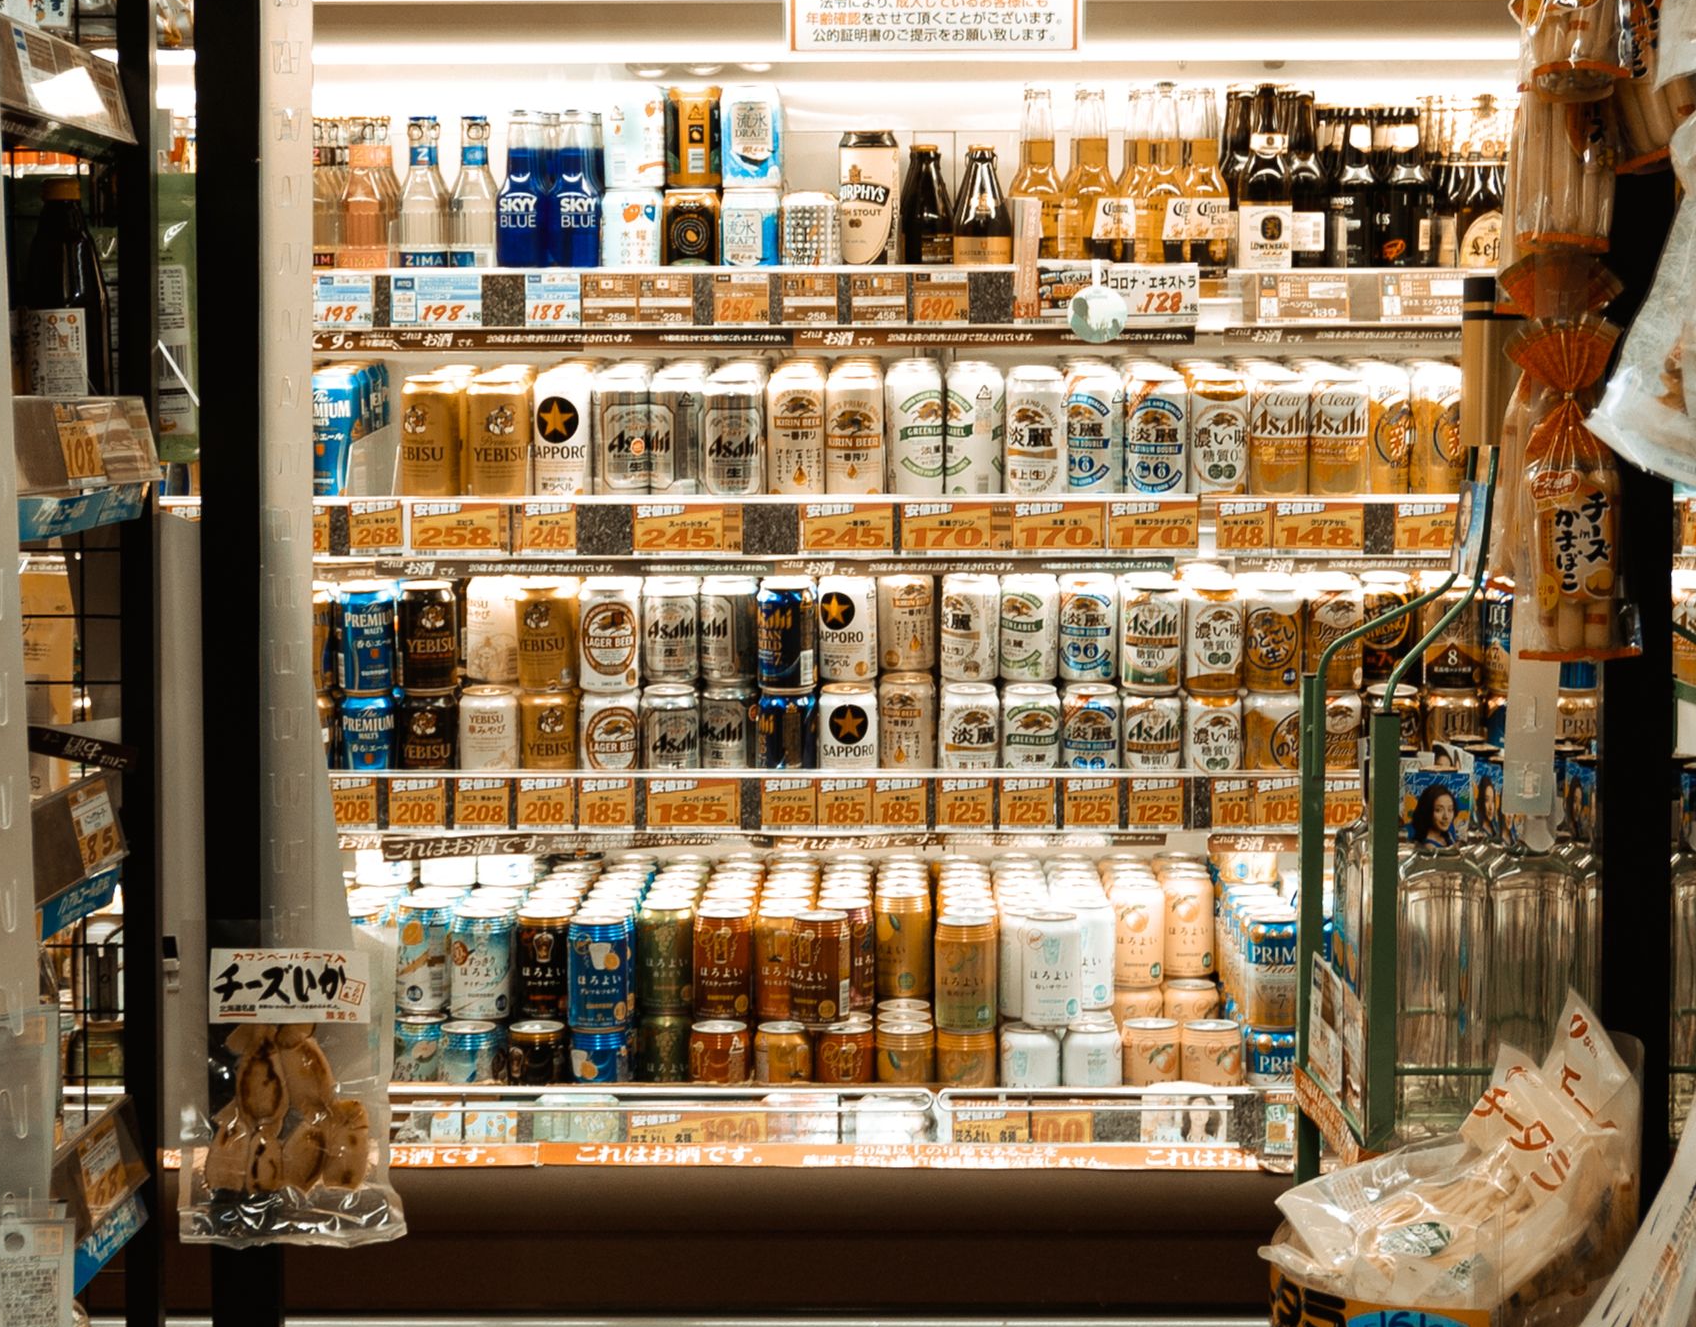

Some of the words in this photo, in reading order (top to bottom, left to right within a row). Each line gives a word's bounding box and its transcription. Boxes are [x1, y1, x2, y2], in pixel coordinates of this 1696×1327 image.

[806, 12, 1062, 26] 年齢確認をさせて頂くことがございます。
[813, 28, 1056, 43] 公的証明書のご提示をお願い致します。
[735, 125, 770, 139] DRAFT
[499, 198, 537, 212] SKYY
[559, 198, 597, 212] SKYY
[499, 215, 537, 229] BLUE
[559, 215, 597, 229] BLUE
[405, 254, 444, 267] ZIMA
[1109, 275, 1197, 289] コロナ・エキストラ
[1264, 393, 1304, 408] Clear
[1318, 393, 1358, 408] Clear
[706, 432, 760, 457] Asahi
[1008, 427, 1054, 450] 淡麗
[1130, 424, 1180, 444] 淡麗
[473, 447, 526, 462] YEBISU
[357, 527, 398, 547] 268
[415, 526, 492, 548] 258
[530, 526, 569, 549] 245
[640, 528, 715, 549] 245
[813, 526, 889, 548] 245
[909, 526, 982, 548] 170
[1018, 526, 1094, 548] 170
[1115, 526, 1188, 547] 170
[1224, 525, 1263, 548] 148
[1278, 526, 1353, 548] 148
[647, 617, 697, 642] Asahi
[1125, 612, 1178, 637] Asahi
[405, 637, 456, 654] YEBISU
[584, 635, 613, 649] LAGER
[614, 636, 636, 650] BEER
[342, 713, 396, 731] PREMIUM
[468, 714, 505, 725] YEBISU
[952, 726, 996, 745] 淡麗
[822, 742, 877, 757] SAPPORO
[394, 802, 436, 823] 208
[462, 802, 504, 824] 208
[523, 800, 565, 823] 208
[585, 801, 623, 824] 185
[655, 802, 728, 823] 185
[769, 803, 810, 824] 185
[947, 802, 987, 824] 125
[1007, 802, 1047, 824] 125
[1072, 802, 1110, 824] 125
[384, 834, 549, 861] これはお酒です。
[1250, 946, 1297, 964] PRIM
[214, 964, 343, 1005] チーズいか
[575, 1144, 766, 1164] これはお酒です。
